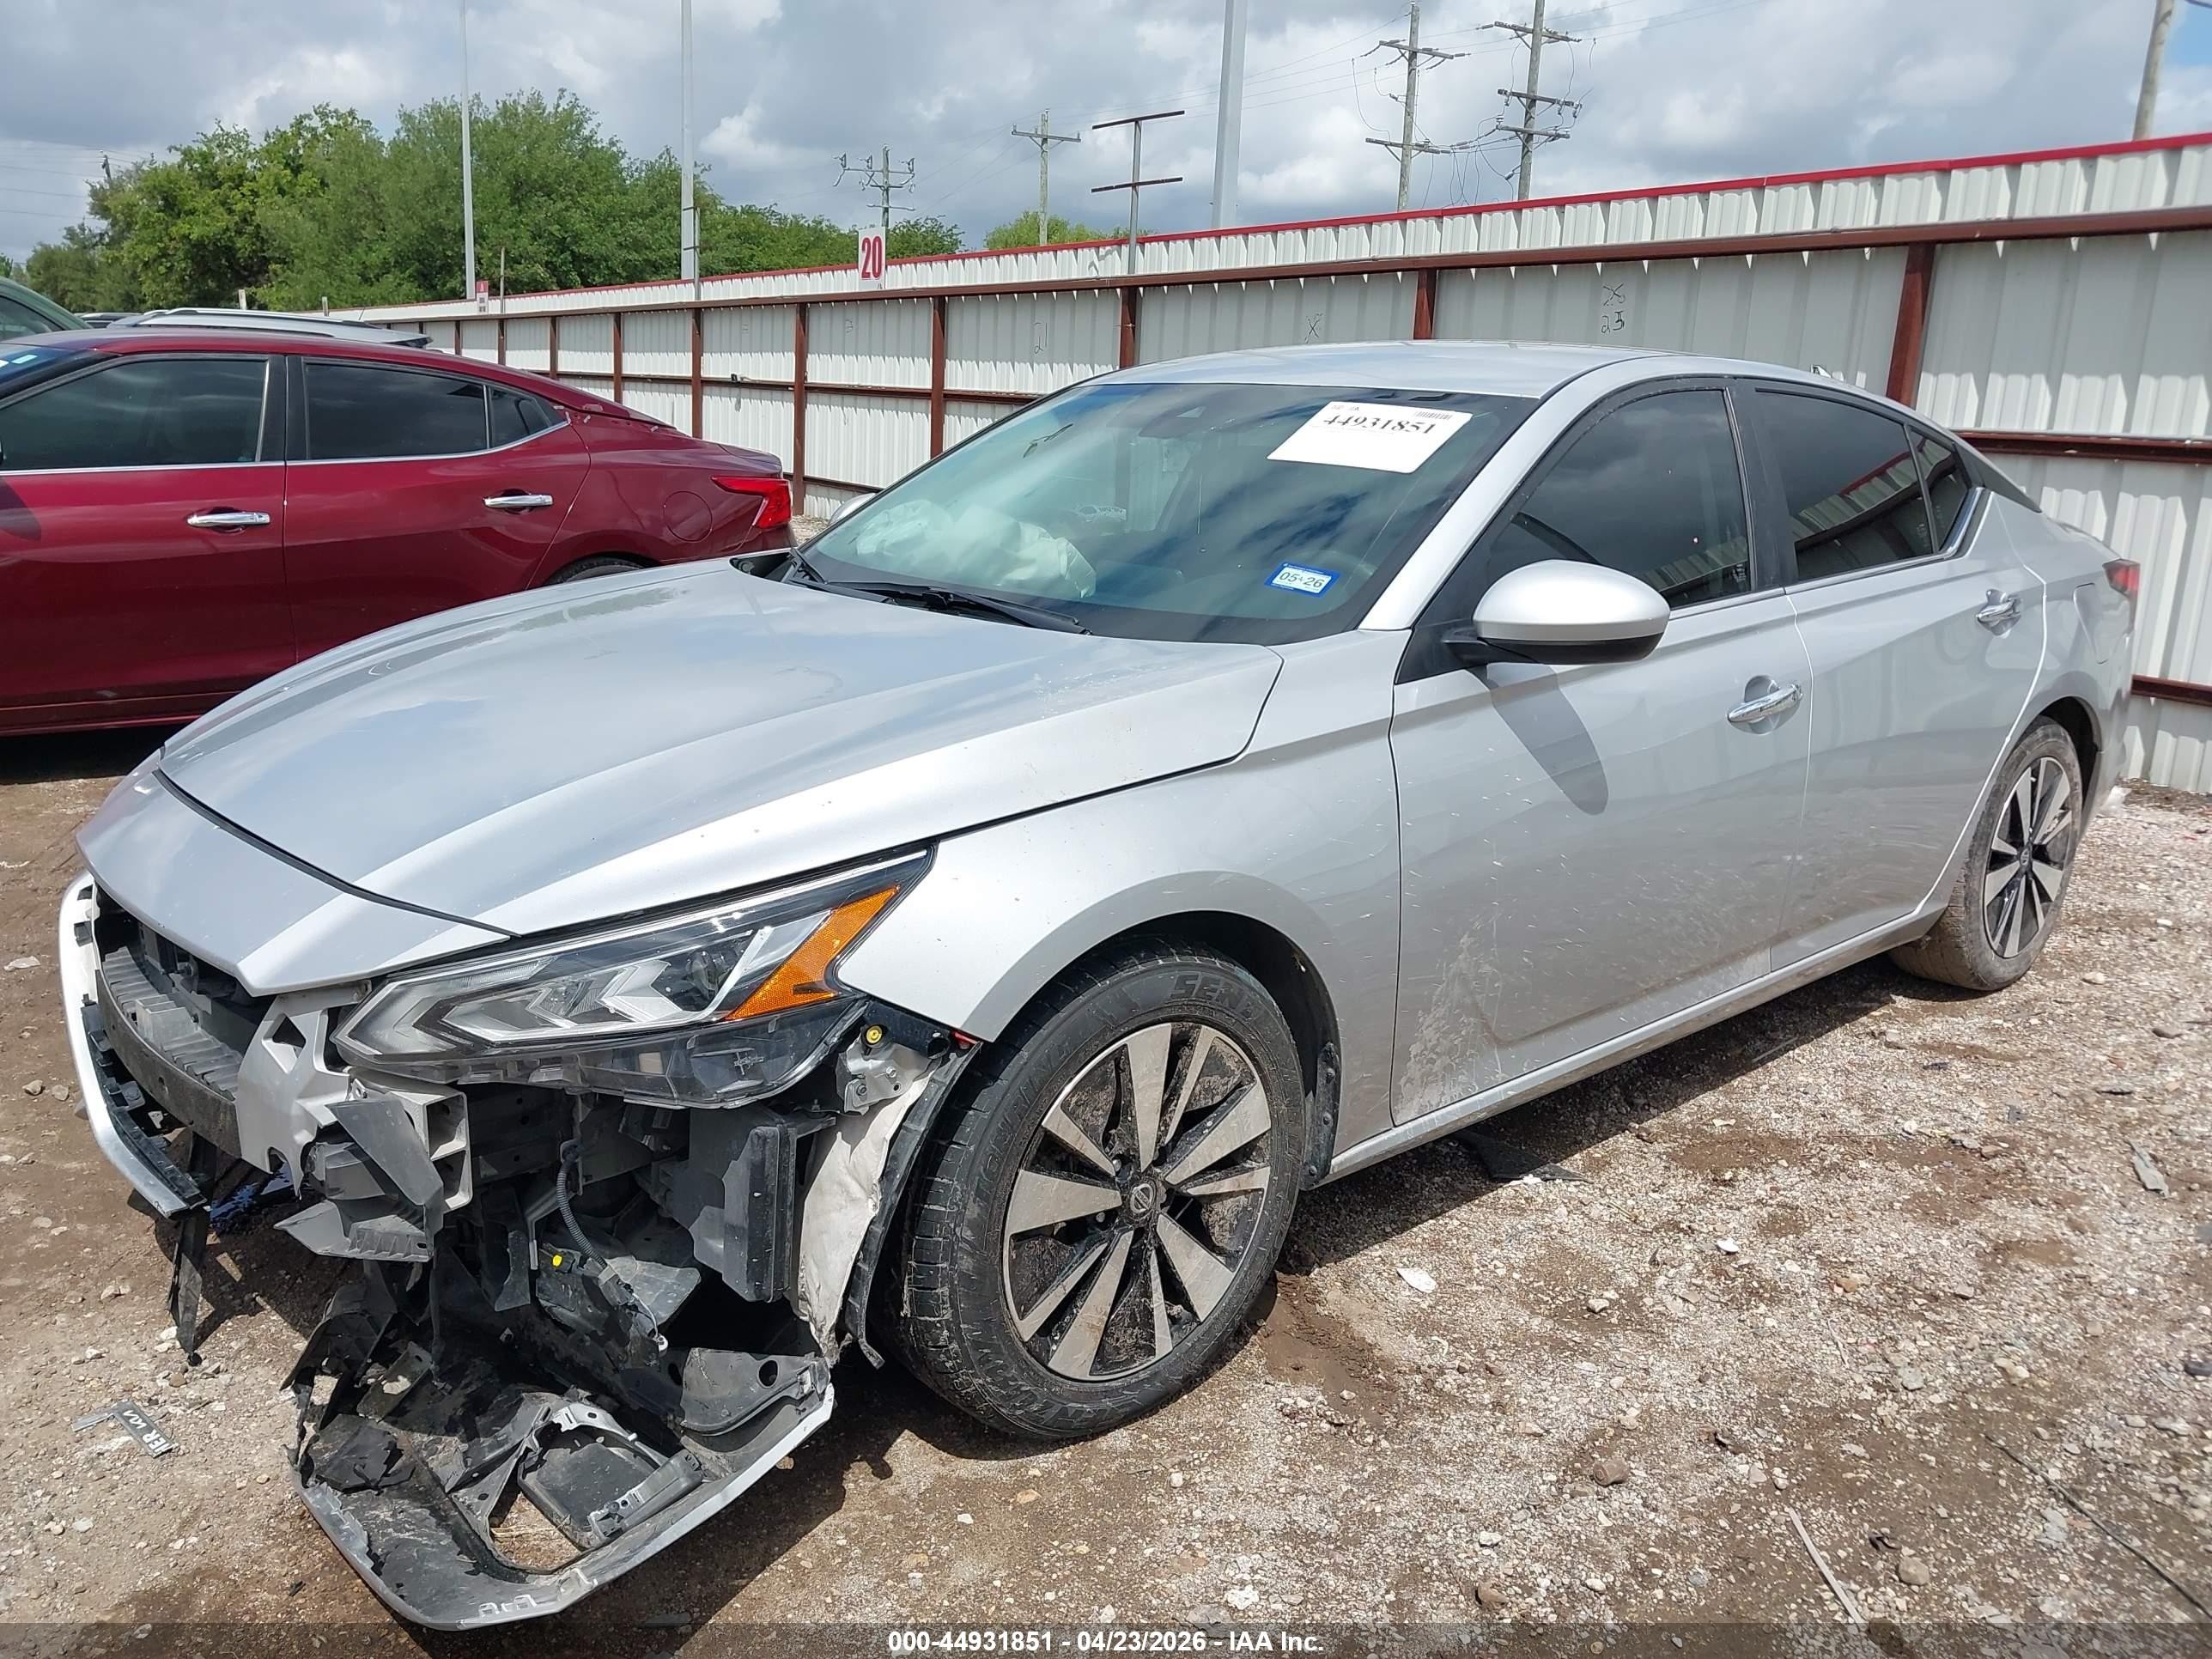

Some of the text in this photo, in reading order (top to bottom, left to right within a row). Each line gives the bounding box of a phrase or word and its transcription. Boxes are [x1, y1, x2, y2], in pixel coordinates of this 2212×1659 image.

[861, 236, 883, 279] 20
[1323, 414, 1437, 434] 44931851
[1279, 571, 1301, 583] 05
[1303, 576, 1326, 588] 26
